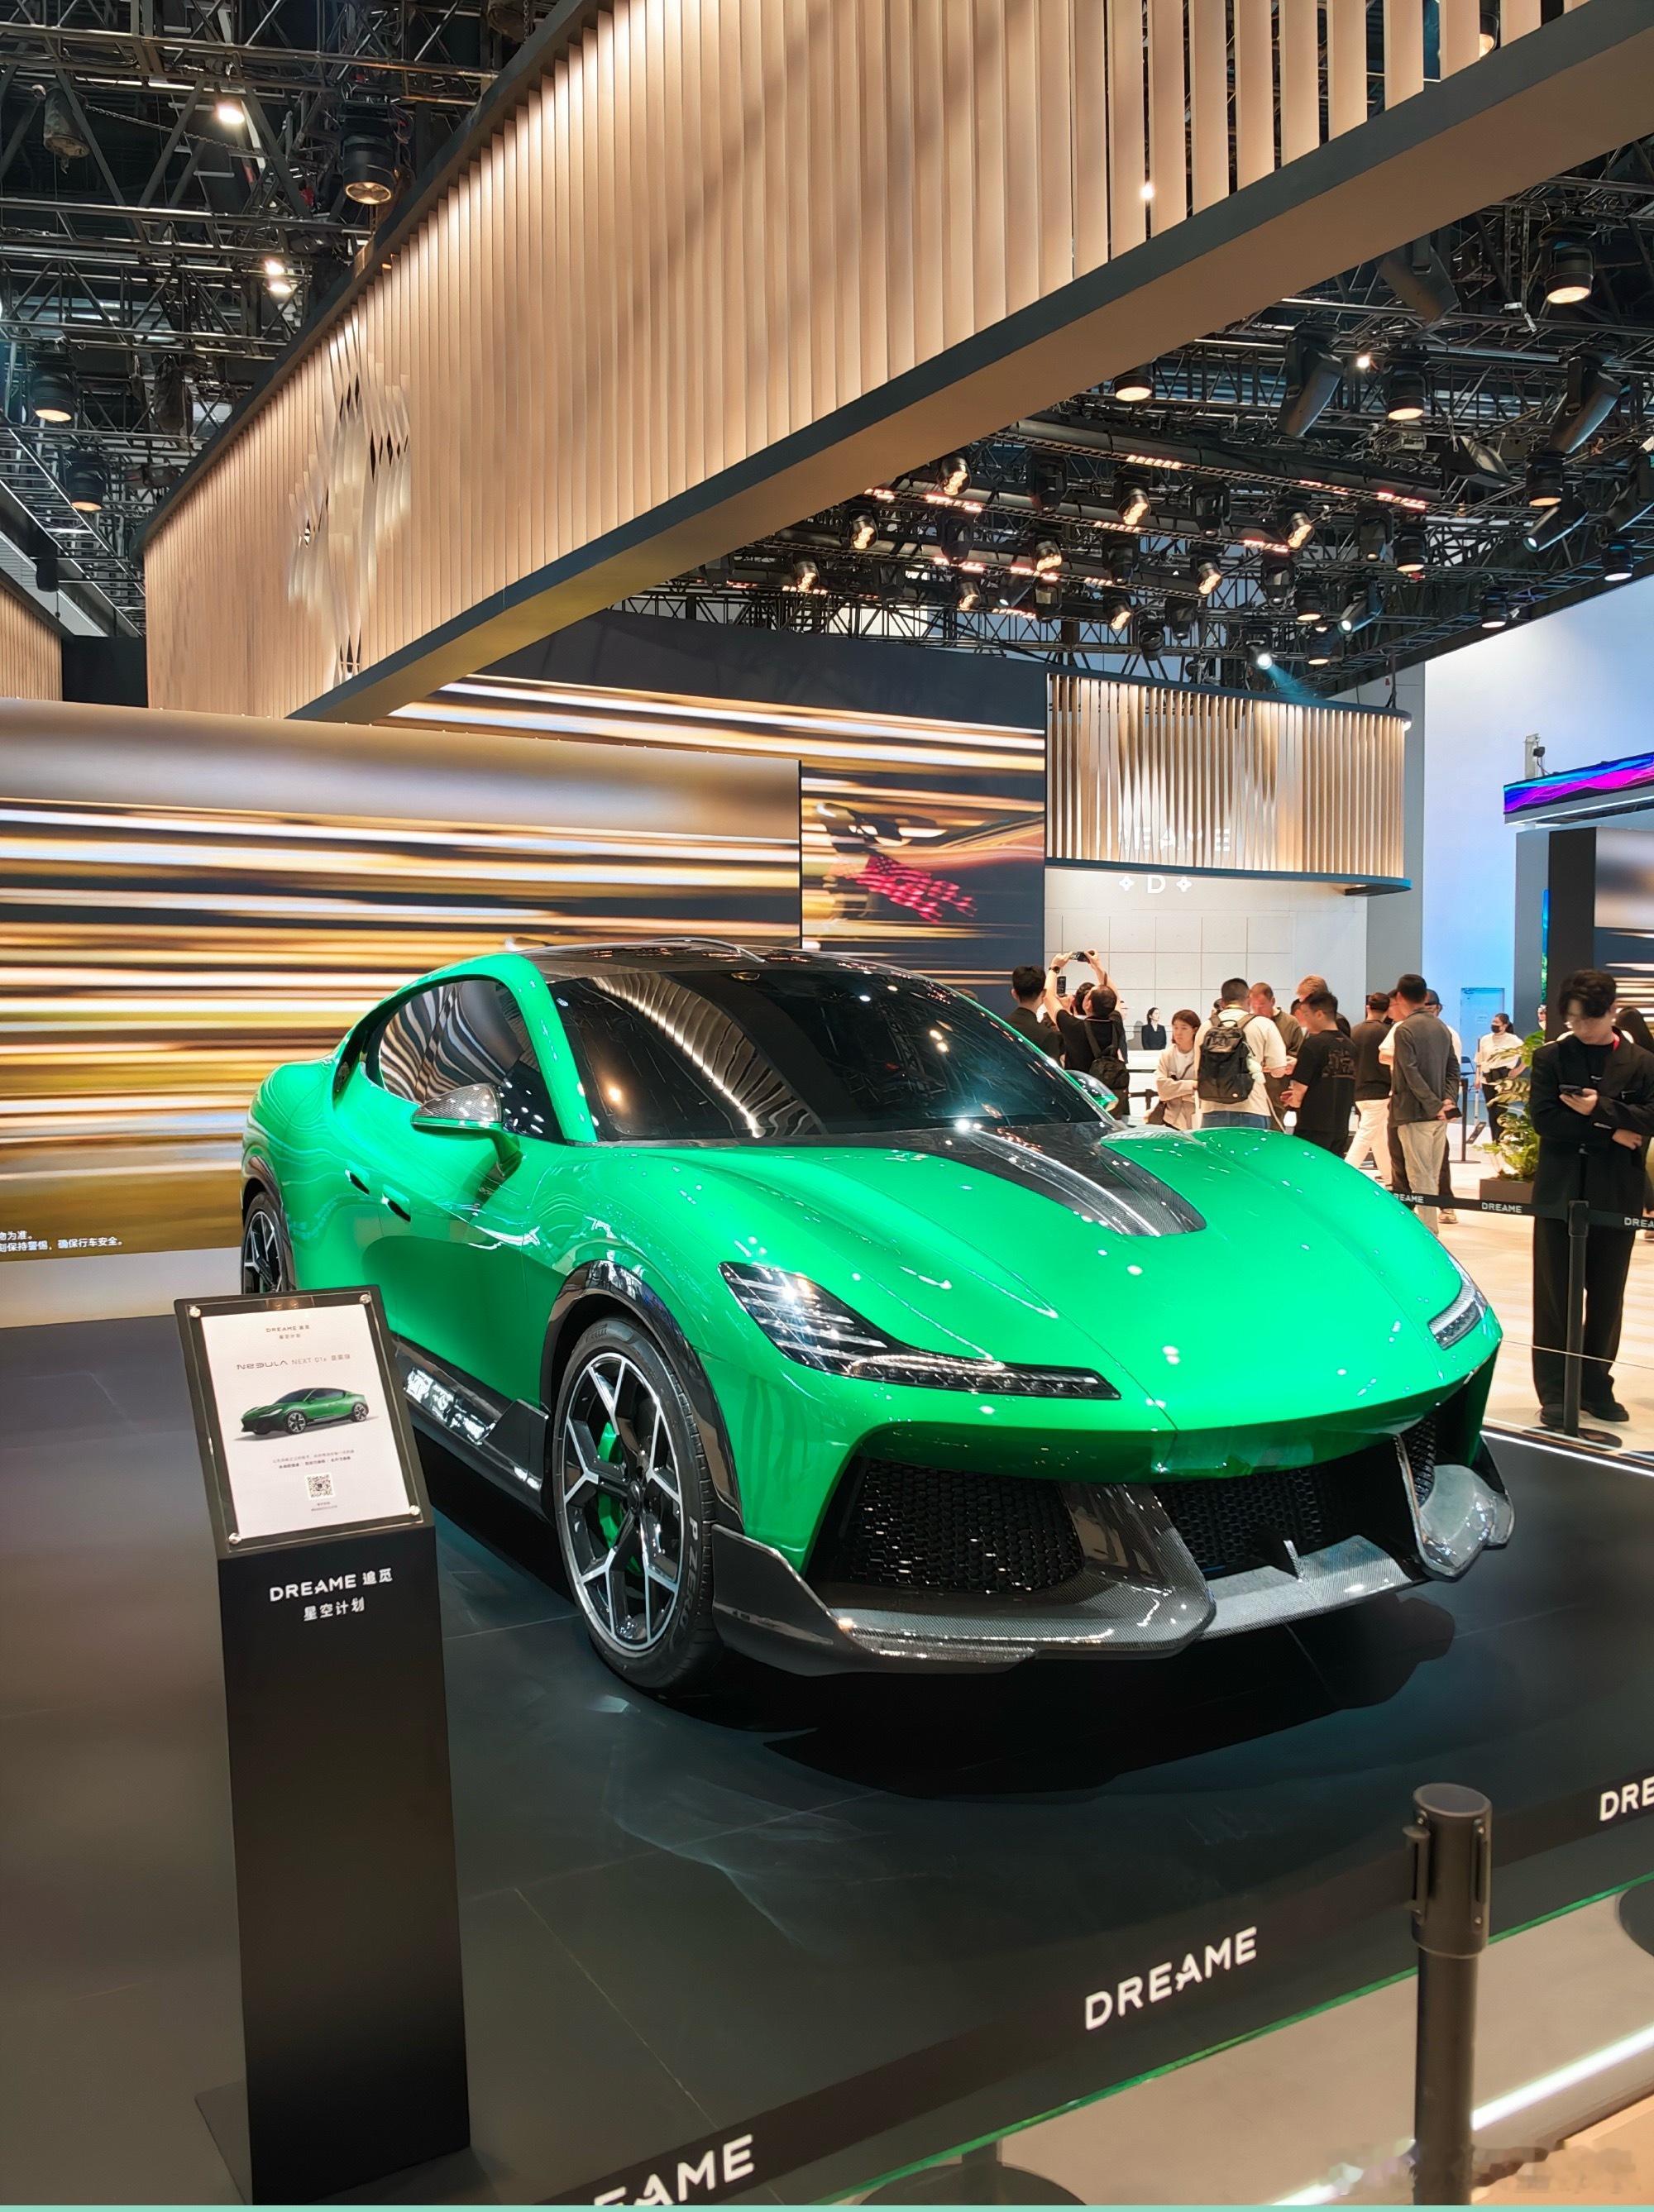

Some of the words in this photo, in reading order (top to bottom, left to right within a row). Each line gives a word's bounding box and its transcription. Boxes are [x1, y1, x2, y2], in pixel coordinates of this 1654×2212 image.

[1147, 874, 1166, 894] D
[1481, 1202, 1523, 1213] DREAME
[689, 1516, 698, 1541] P
[270, 1574, 356, 1602] DREAME
[362, 1568, 393, 1585] 追觅
[304, 1597, 365, 1622] 星空计划
[1599, 1775, 1654, 1822] DRE
[1085, 1926, 1257, 2031] DREAME
